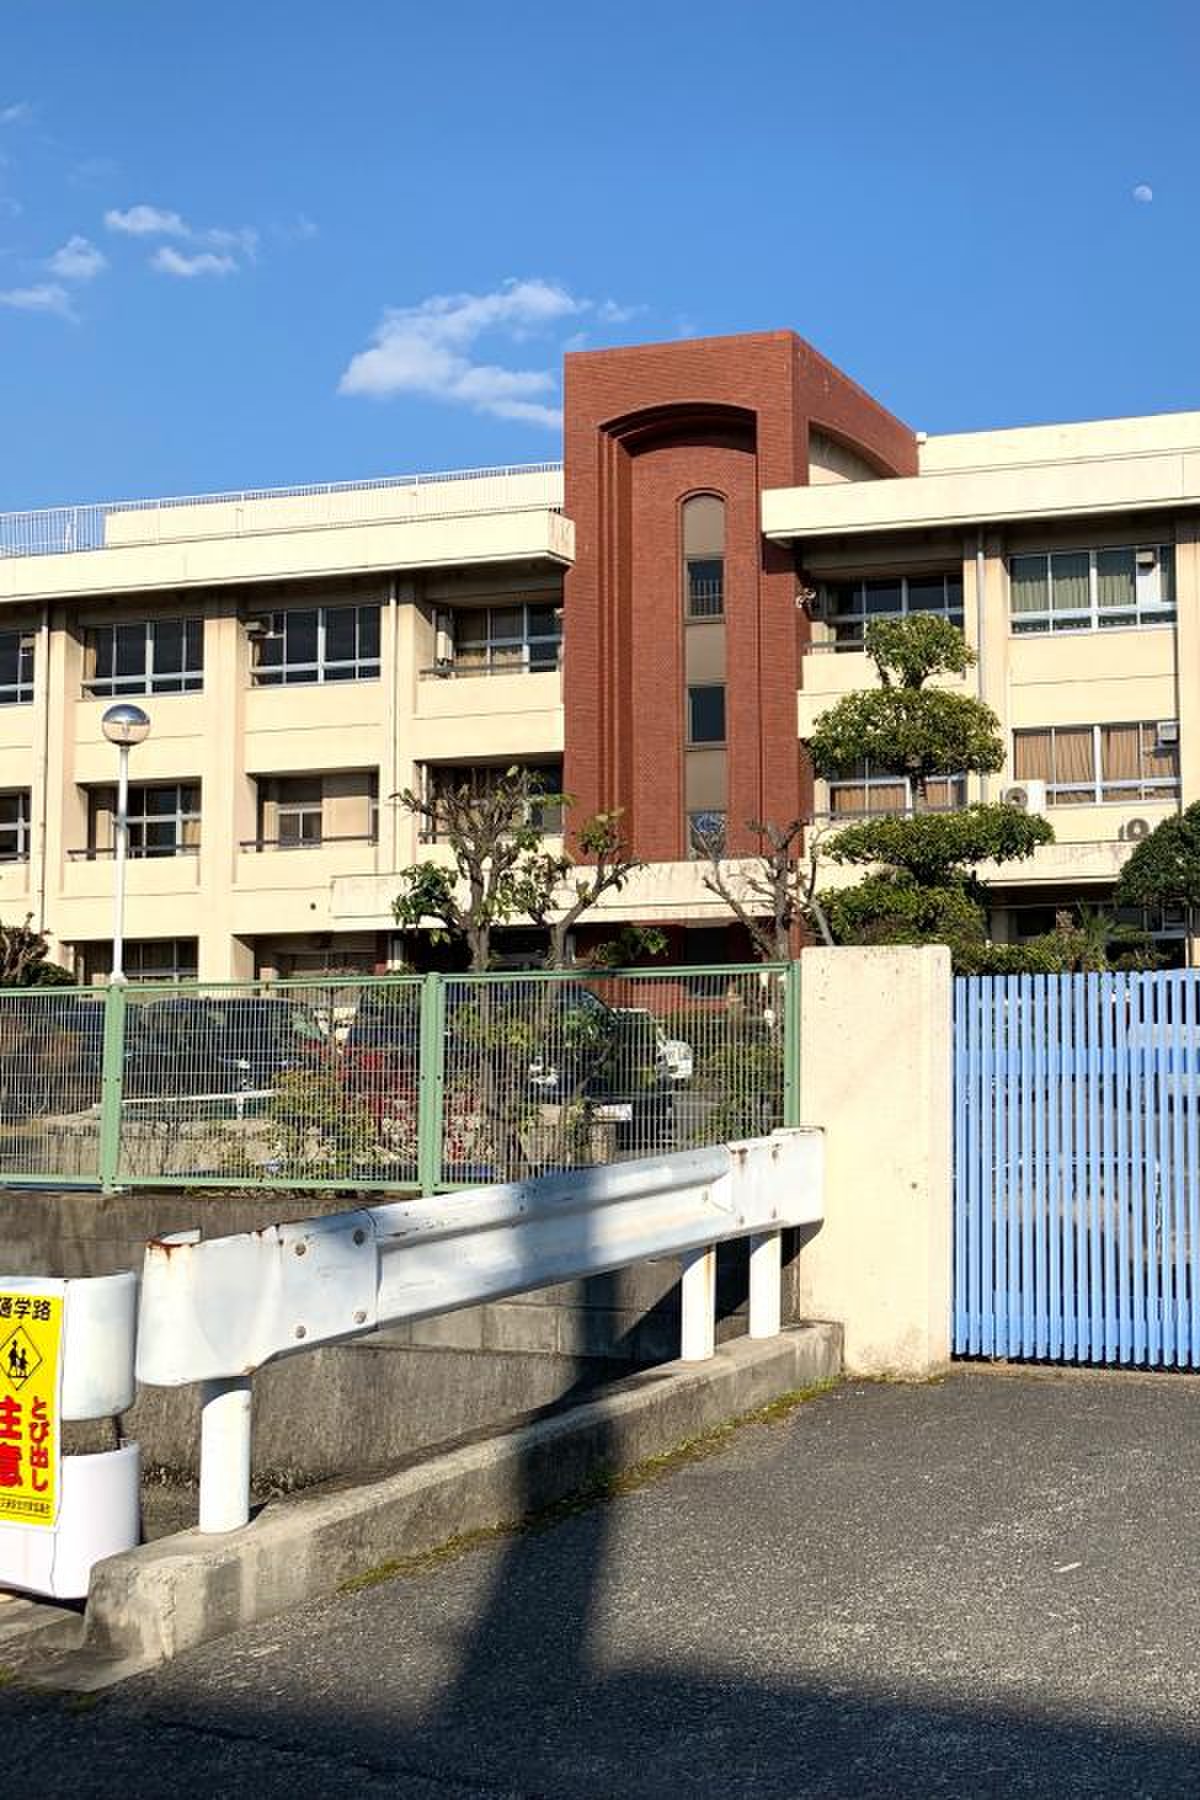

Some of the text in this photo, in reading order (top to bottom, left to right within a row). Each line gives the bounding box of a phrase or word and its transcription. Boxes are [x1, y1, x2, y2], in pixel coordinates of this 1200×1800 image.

[0, 1297, 50, 1321] 通学路
[28, 1396, 50, 1491] とび出し
